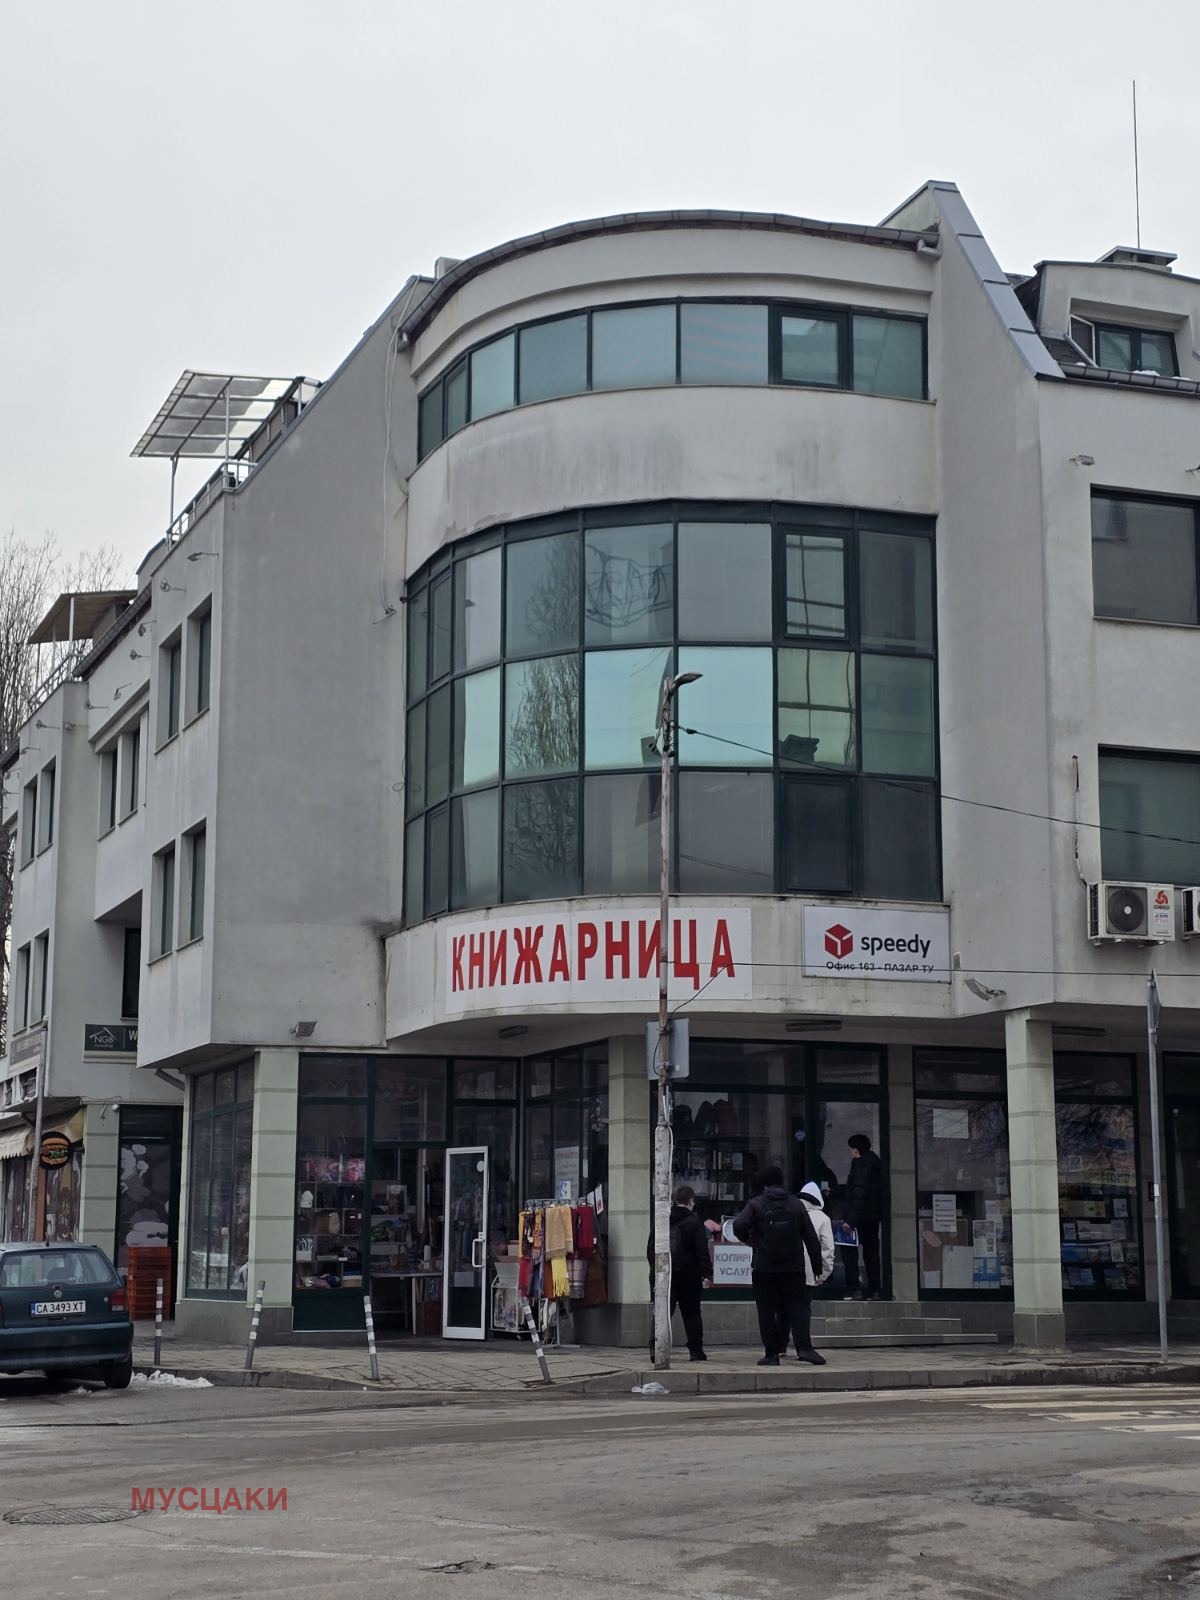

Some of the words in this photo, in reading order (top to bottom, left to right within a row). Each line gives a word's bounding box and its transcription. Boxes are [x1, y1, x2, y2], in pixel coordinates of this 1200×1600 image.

[861, 933, 931, 958] speedy
[451, 918, 735, 993] КНИЖАРНИЦА
[826, 961, 856, 972] Офис
[859, 962, 875, 971] 163
[884, 963, 919, 973] ПАЗАР
[922, 965, 934, 973] ТУ
[94, 1035, 114, 1044] NGB
[719, 1267, 752, 1276] УСЛУГ
[50, 1302, 71, 1313] 3493
